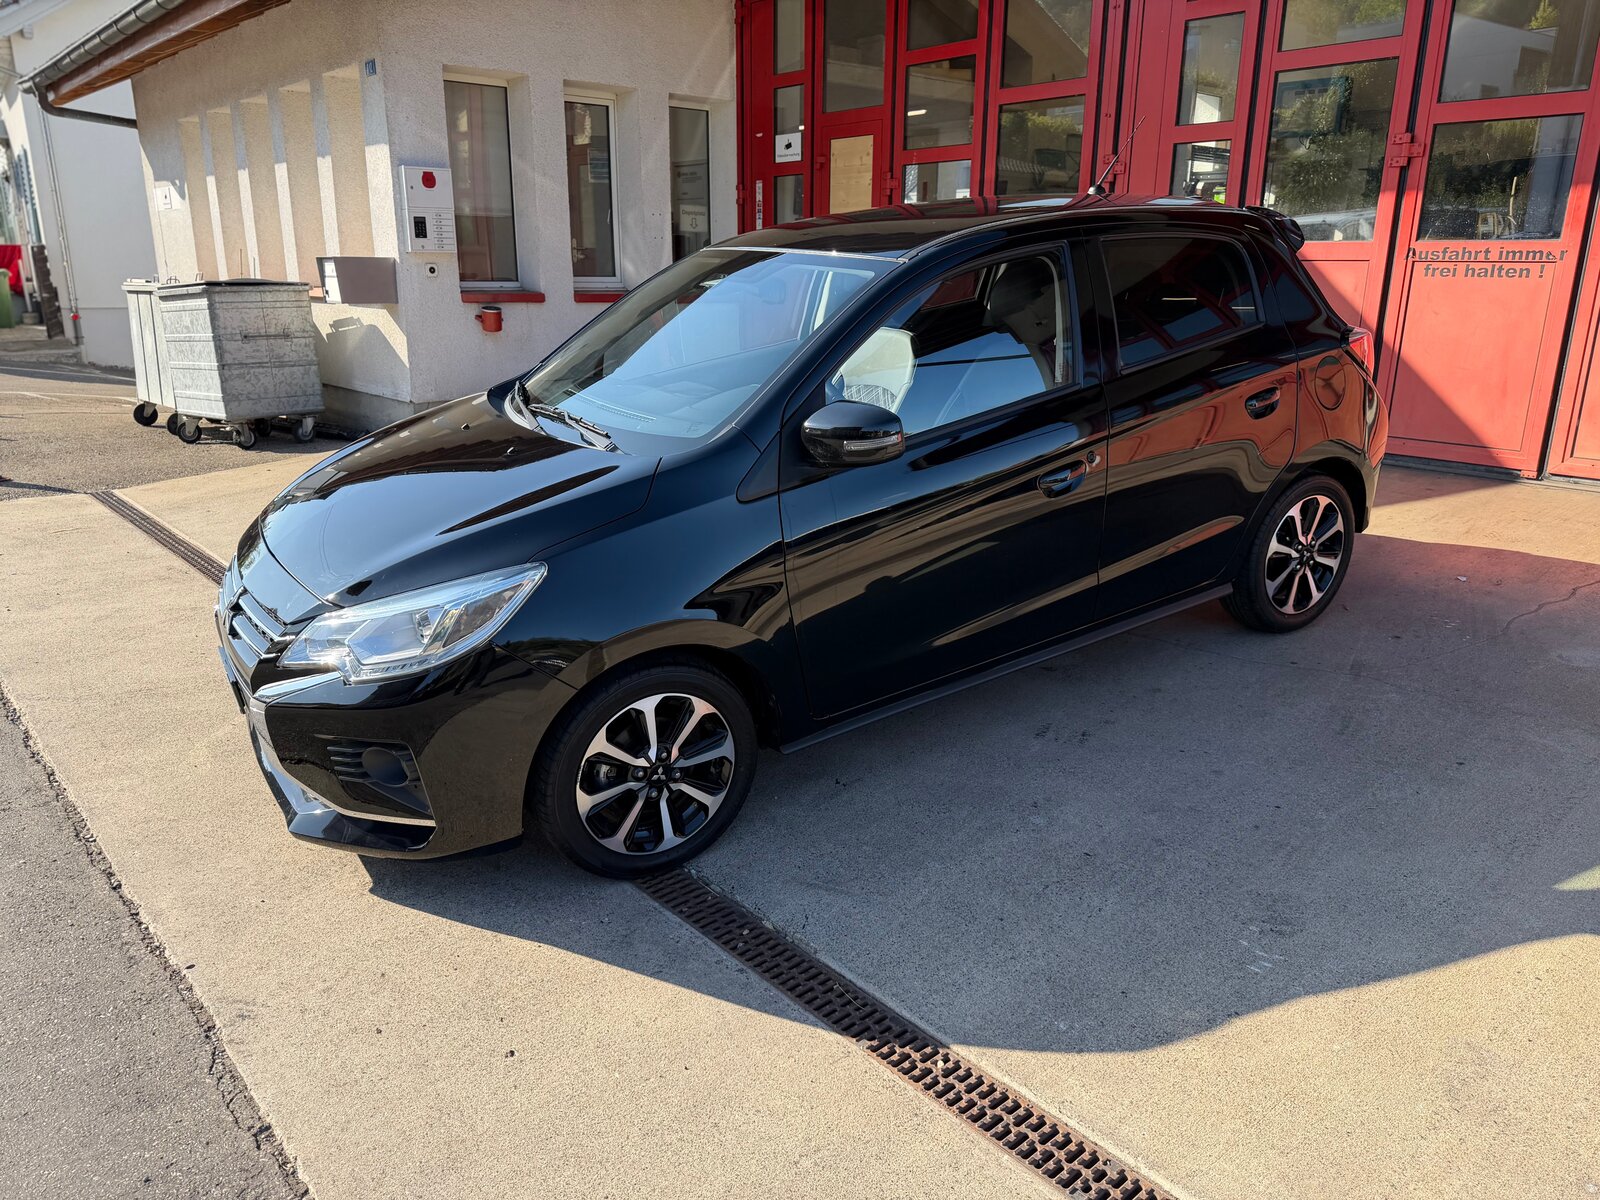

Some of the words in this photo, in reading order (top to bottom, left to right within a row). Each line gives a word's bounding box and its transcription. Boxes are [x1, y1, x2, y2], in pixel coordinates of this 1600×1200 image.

[1404, 247, 1491, 261] Ausfahrt
[1498, 247, 1568, 261] immer
[1423, 264, 1458, 278] frei
[1464, 264, 1532, 278] halten
[1538, 264, 1546, 279] !
